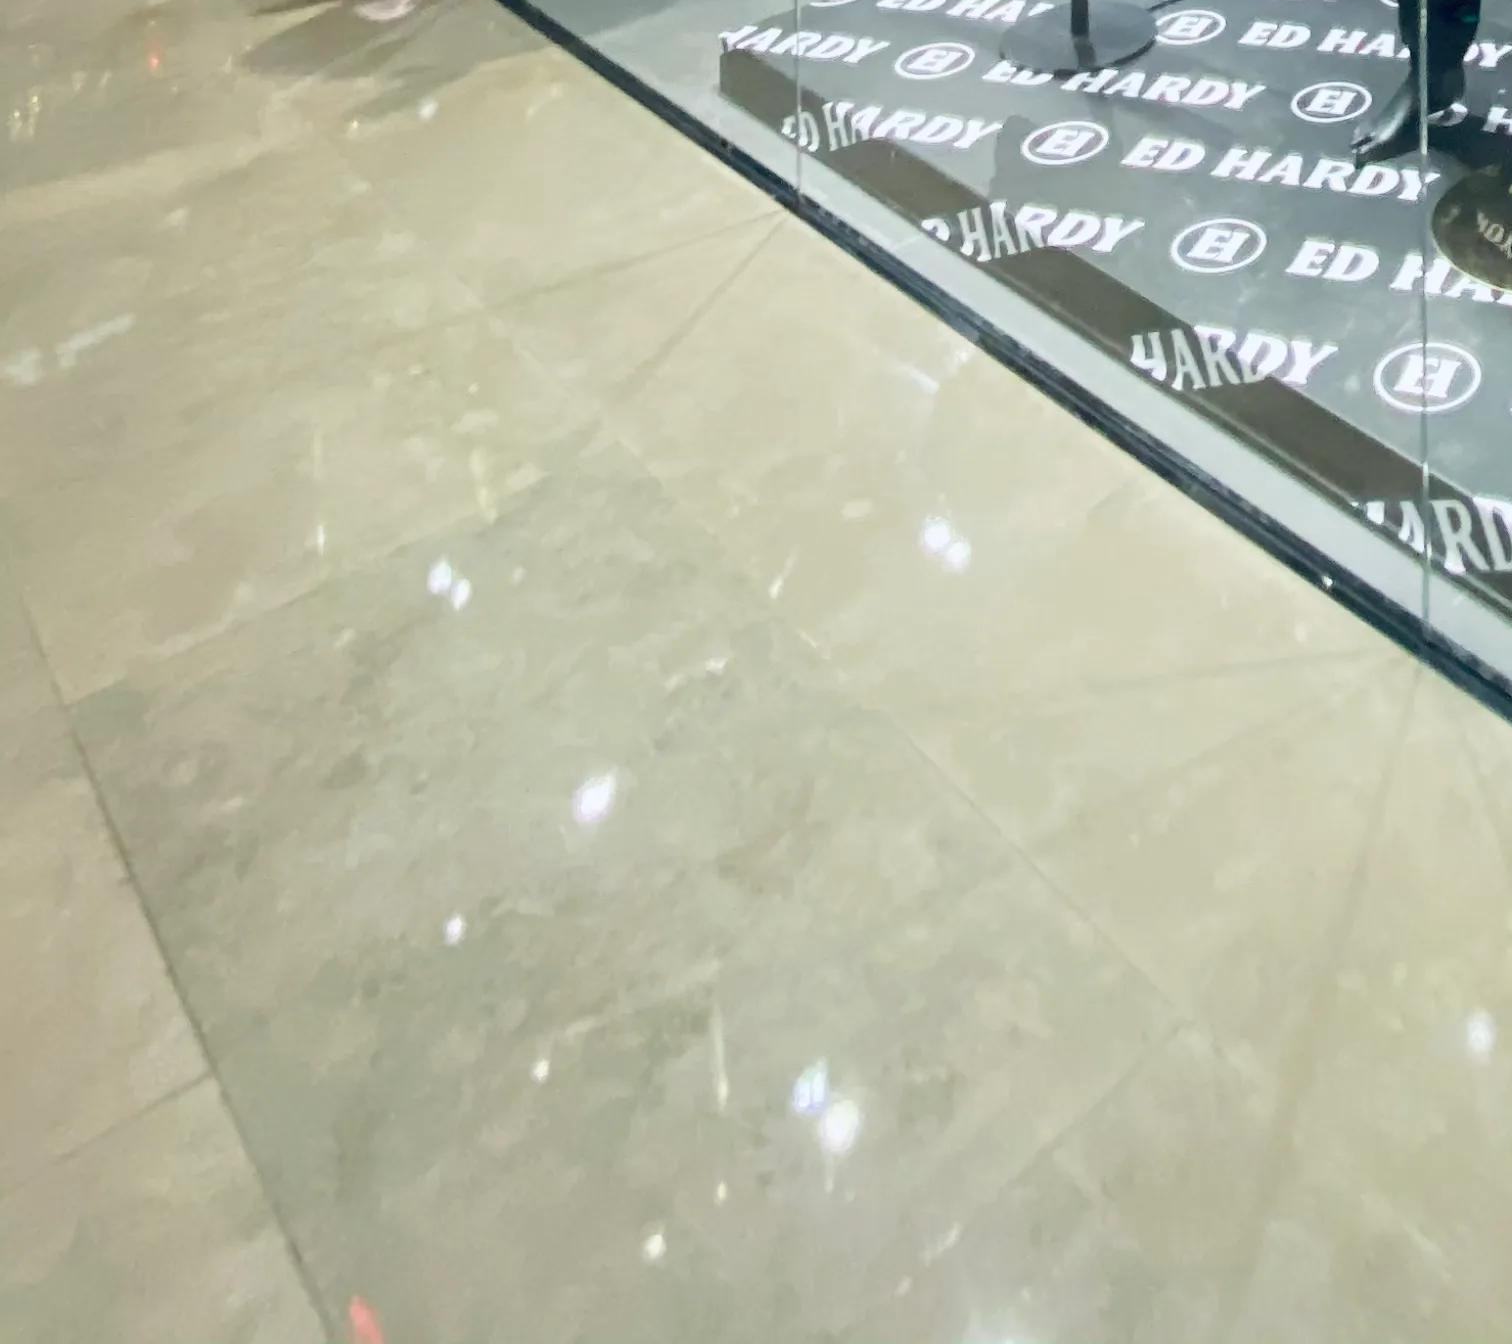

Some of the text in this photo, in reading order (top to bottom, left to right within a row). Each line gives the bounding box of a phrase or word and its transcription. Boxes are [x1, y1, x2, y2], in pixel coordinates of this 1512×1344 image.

[1238, 21, 1311, 49] ED
[1061, 67, 1267, 111] HARDY
[822, 100, 1004, 152] HARDY
[1121, 137, 1441, 202] ED HARDY
[957, 200, 1146, 263] HARDY
[1284, 237, 1381, 284] ED
[1129, 323, 1340, 393] HARDY
